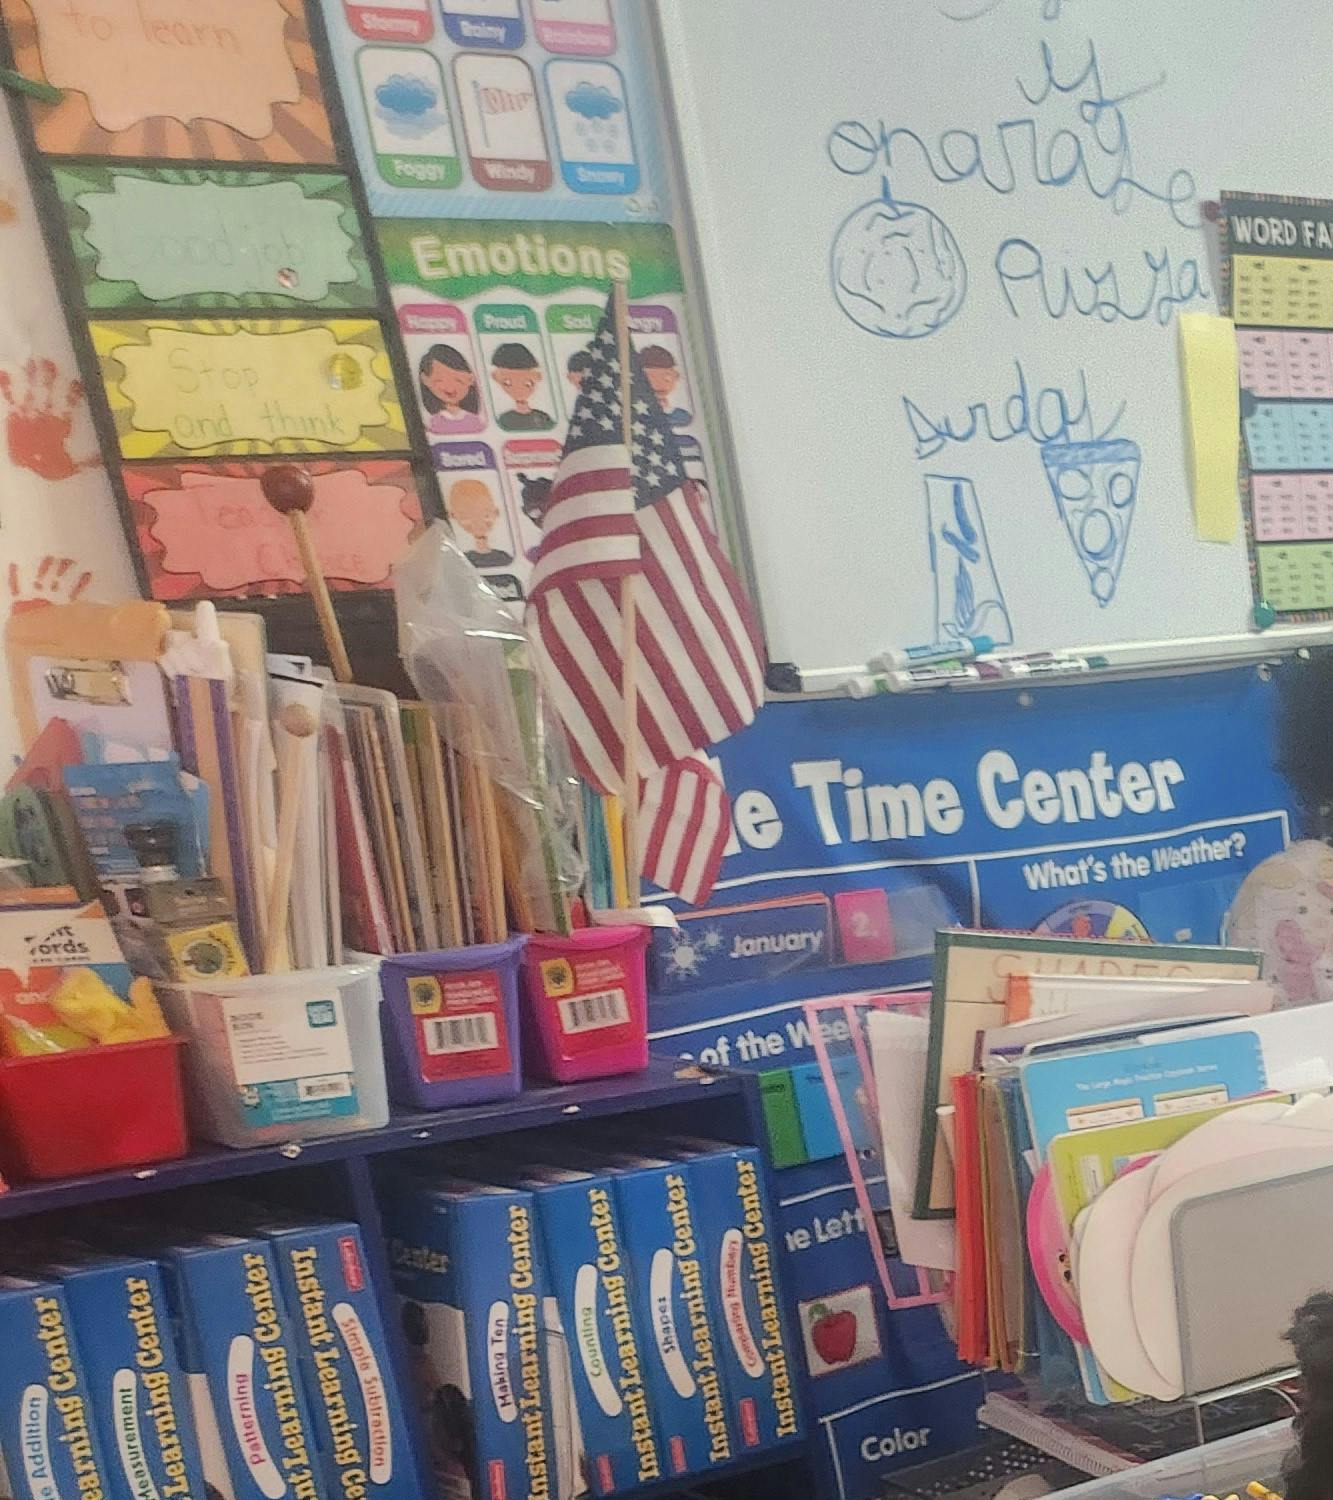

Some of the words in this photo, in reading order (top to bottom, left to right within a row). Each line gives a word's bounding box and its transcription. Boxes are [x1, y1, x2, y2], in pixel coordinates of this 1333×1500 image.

[409, 232, 632, 282] Emotions
[1231, 215, 1297, 246] WORD
[483, 312, 529, 331] Proud
[627, 315, 670, 334] ngry
[791, 760, 966, 846] Time
[976, 749, 1186, 830] Center
[1022, 855, 1108, 892] What's
[1110, 848, 1150, 880] the
[1151, 831, 1248, 876] Weather?
[728, 929, 825, 959] January
[700, 1035, 730, 1067] of
[736, 1029, 785, 1061] the
[786, 1018, 850, 1050] Wee
[588, 1189, 620, 1272] Center
[665, 1174, 696, 1256] Center
[735, 1160, 764, 1238] Center
[814, 1208, 867, 1243] Lett
[507, 1206, 534, 1289] Center
[125, 1277, 164, 1369] Center
[242, 1252, 282, 1343] Center
[602, 1274, 641, 1390] Learning
[654, 1295, 678, 1358] Shapes
[677, 1259, 716, 1373] Learning
[747, 1241, 783, 1349] Learning
[31, 1295, 77, 1393] Center
[291, 1247, 334, 1346] Instant
[313, 1346, 363, 1465] Learning
[511, 1291, 542, 1409] Learning
[142, 1370, 193, 1499] Learning
[260, 1346, 310, 1473] Learning
[620, 1388, 661, 1482] Instant
[696, 1372, 731, 1463] Instant
[763, 1349, 798, 1437] Instant
[26, 1396, 48, 1481] Addition
[859, 1423, 934, 1463] Color
